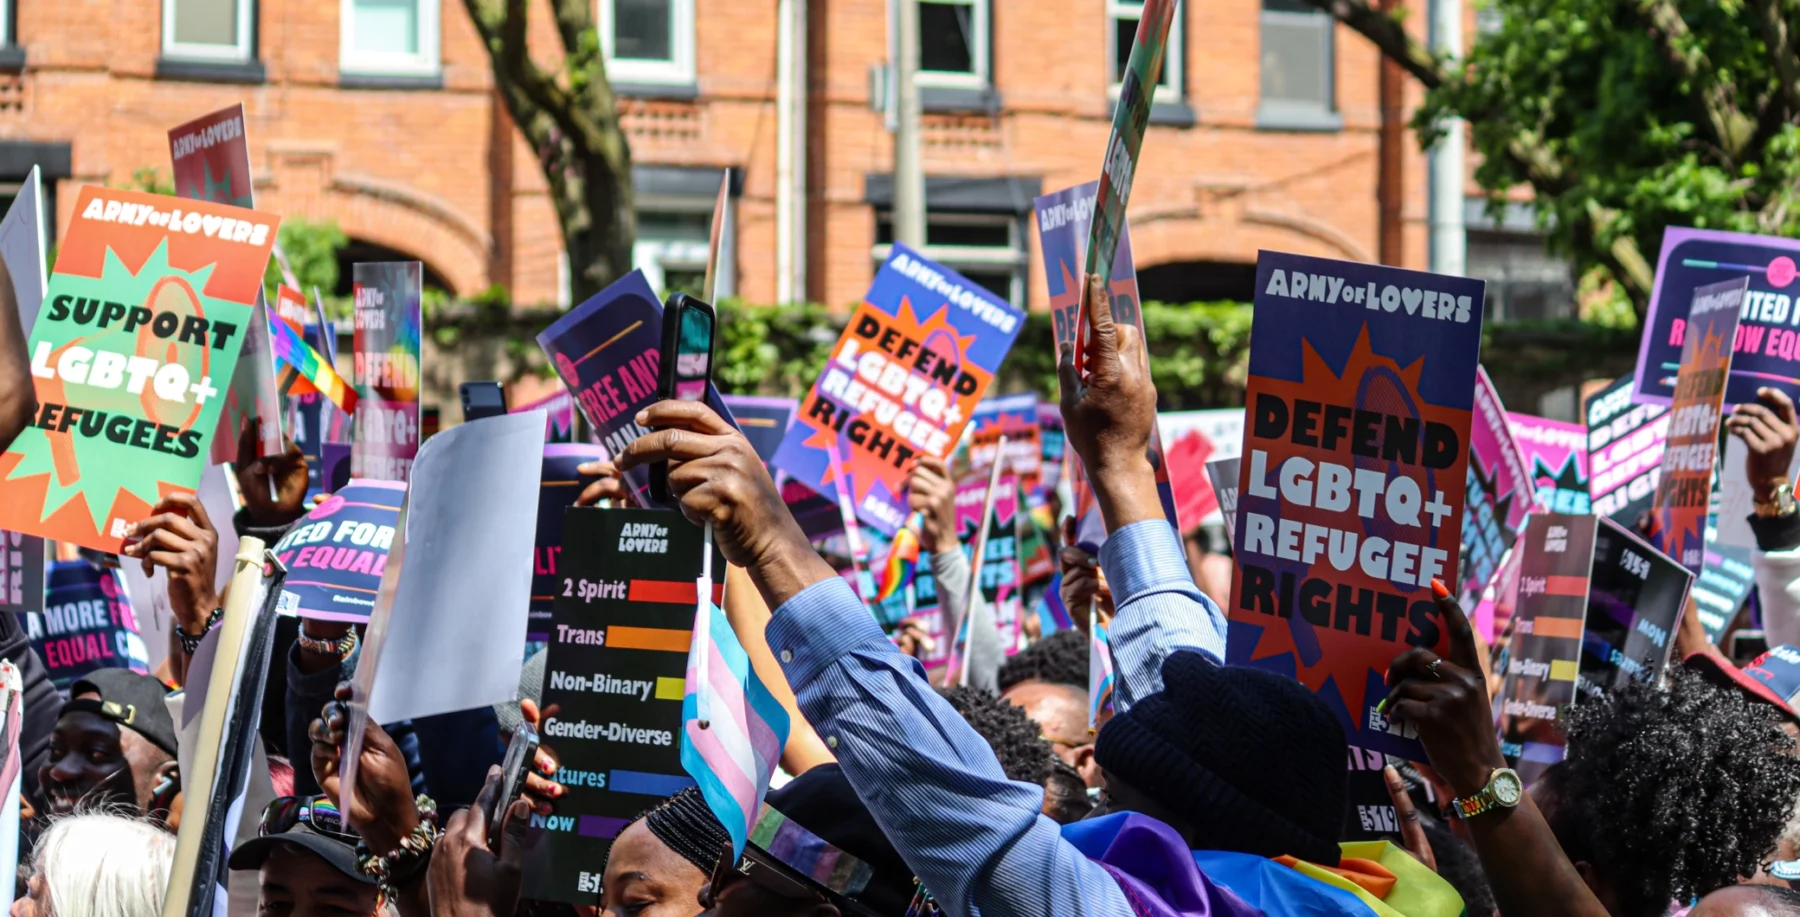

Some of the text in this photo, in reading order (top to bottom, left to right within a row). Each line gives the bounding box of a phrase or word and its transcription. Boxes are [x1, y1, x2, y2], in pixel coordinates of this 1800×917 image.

[82, 198, 149, 227] ARMY
[169, 208, 270, 247] LOVERS
[889, 252, 941, 292] ARMY
[948, 284, 1017, 334] LOVERS
[1265, 268, 1344, 304] ARMY
[1366, 282, 1472, 323] LOVERS
[47, 294, 237, 350] SUPPORT
[31, 341, 218, 404] LGBTQ+
[355, 352, 418, 388] DEFEND
[855, 313, 977, 396] DEFEND
[578, 374, 629, 427] FREE
[836, 338, 963, 426] LGBTQ+
[808, 396, 918, 469] RIGHT
[821, 368, 952, 457] REFUGEE
[1253, 392, 1459, 470] DEFEND
[1248, 449, 1452, 528] LGBTQ+
[332, 519, 396, 550] FOR
[618, 538, 669, 553] LOVERS
[620, 522, 657, 538] ARMY
[1243, 512, 1449, 590] REFUGEE
[562, 578, 627, 603] 2 Spirit
[1239, 564, 1441, 648] RIGHTS
[26, 612, 43, 640] A
[45, 600, 108, 634] MORE
[557, 624, 605, 645] Trans
[44, 634, 113, 668] EQUAL
[550, 671, 653, 702] Non-Binary
[544, 717, 672, 746] Gender-Diverse
[530, 812, 575, 832] Now
